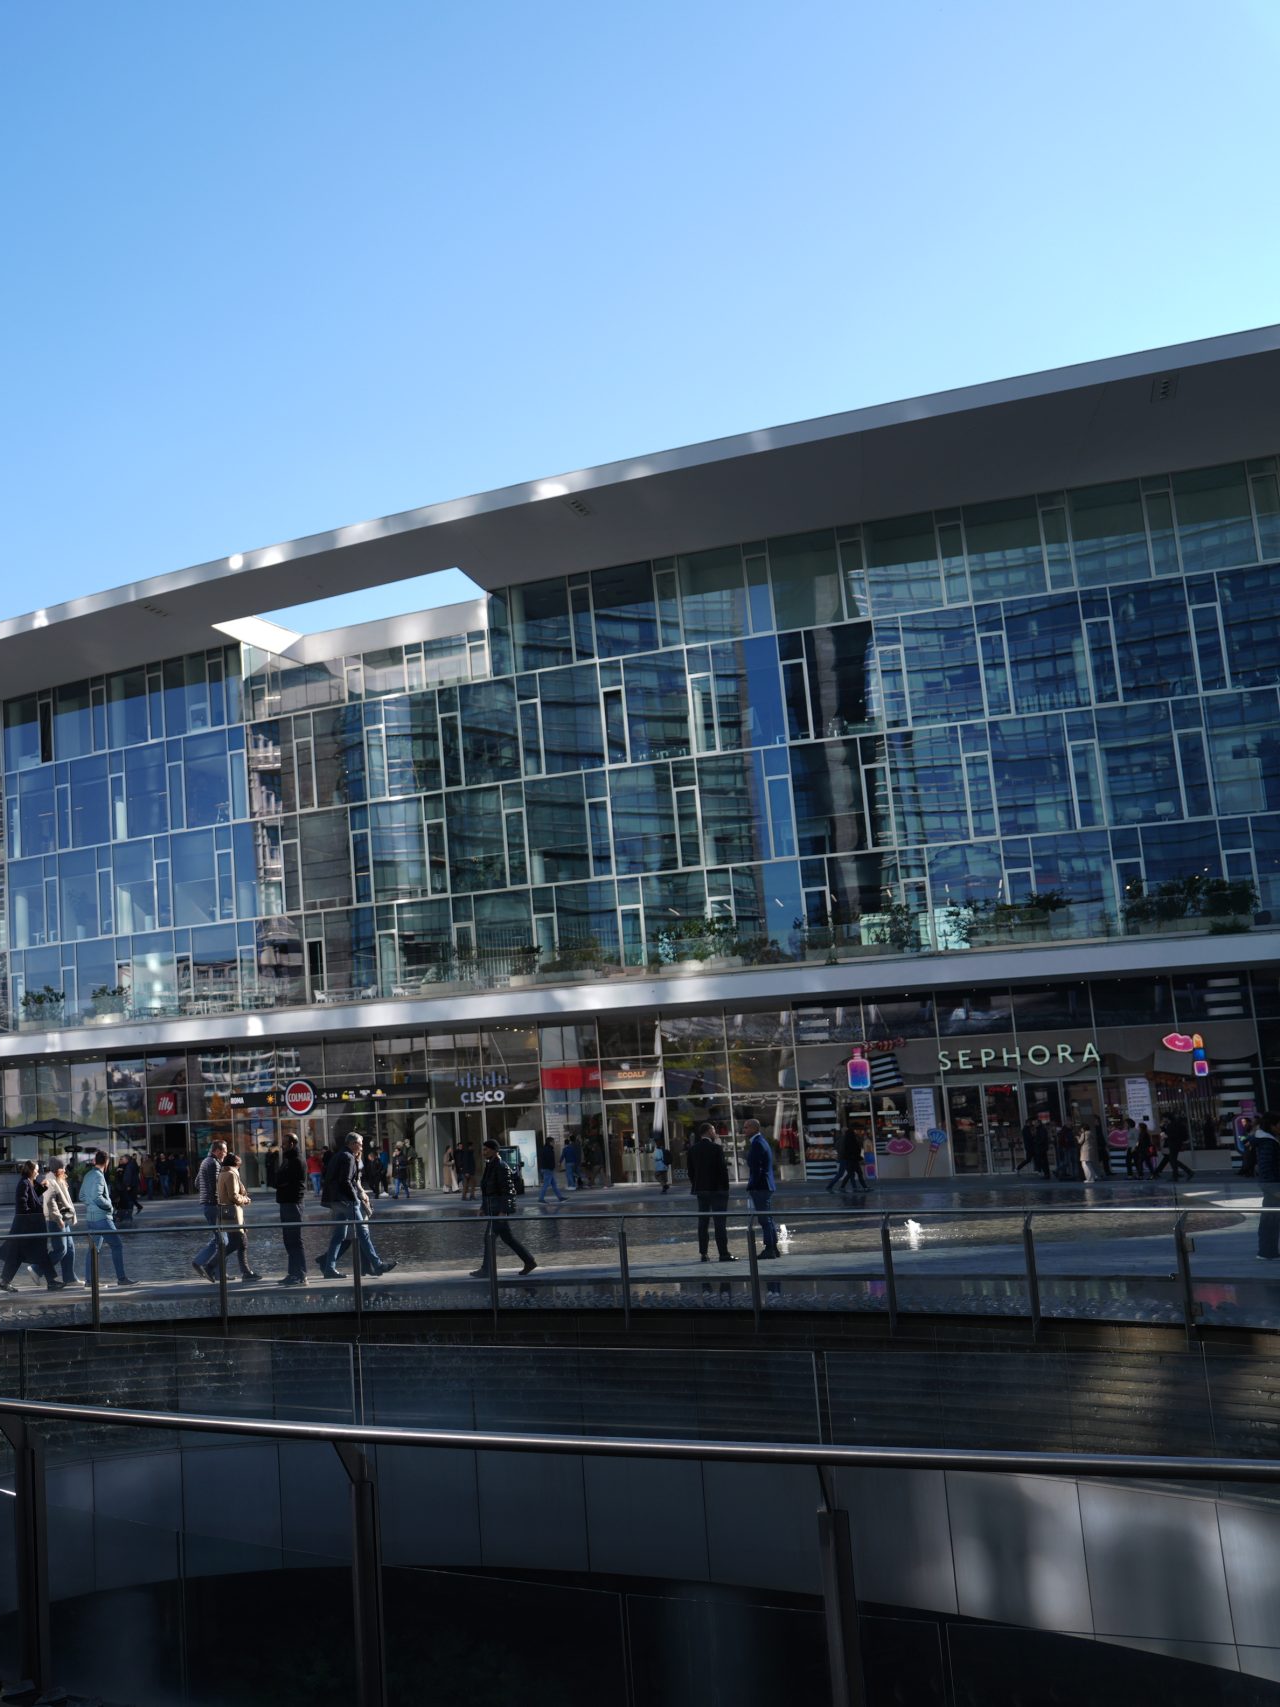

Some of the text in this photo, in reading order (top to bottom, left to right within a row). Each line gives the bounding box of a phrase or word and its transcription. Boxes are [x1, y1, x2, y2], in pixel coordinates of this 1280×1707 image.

[938, 1042, 1101, 1071] SEPHORA
[616, 1071, 648, 1079] ECOALF
[288, 1092, 312, 1103] COLMAR
[461, 1090, 506, 1103] CISCO
[158, 1096, 174, 1114] illy
